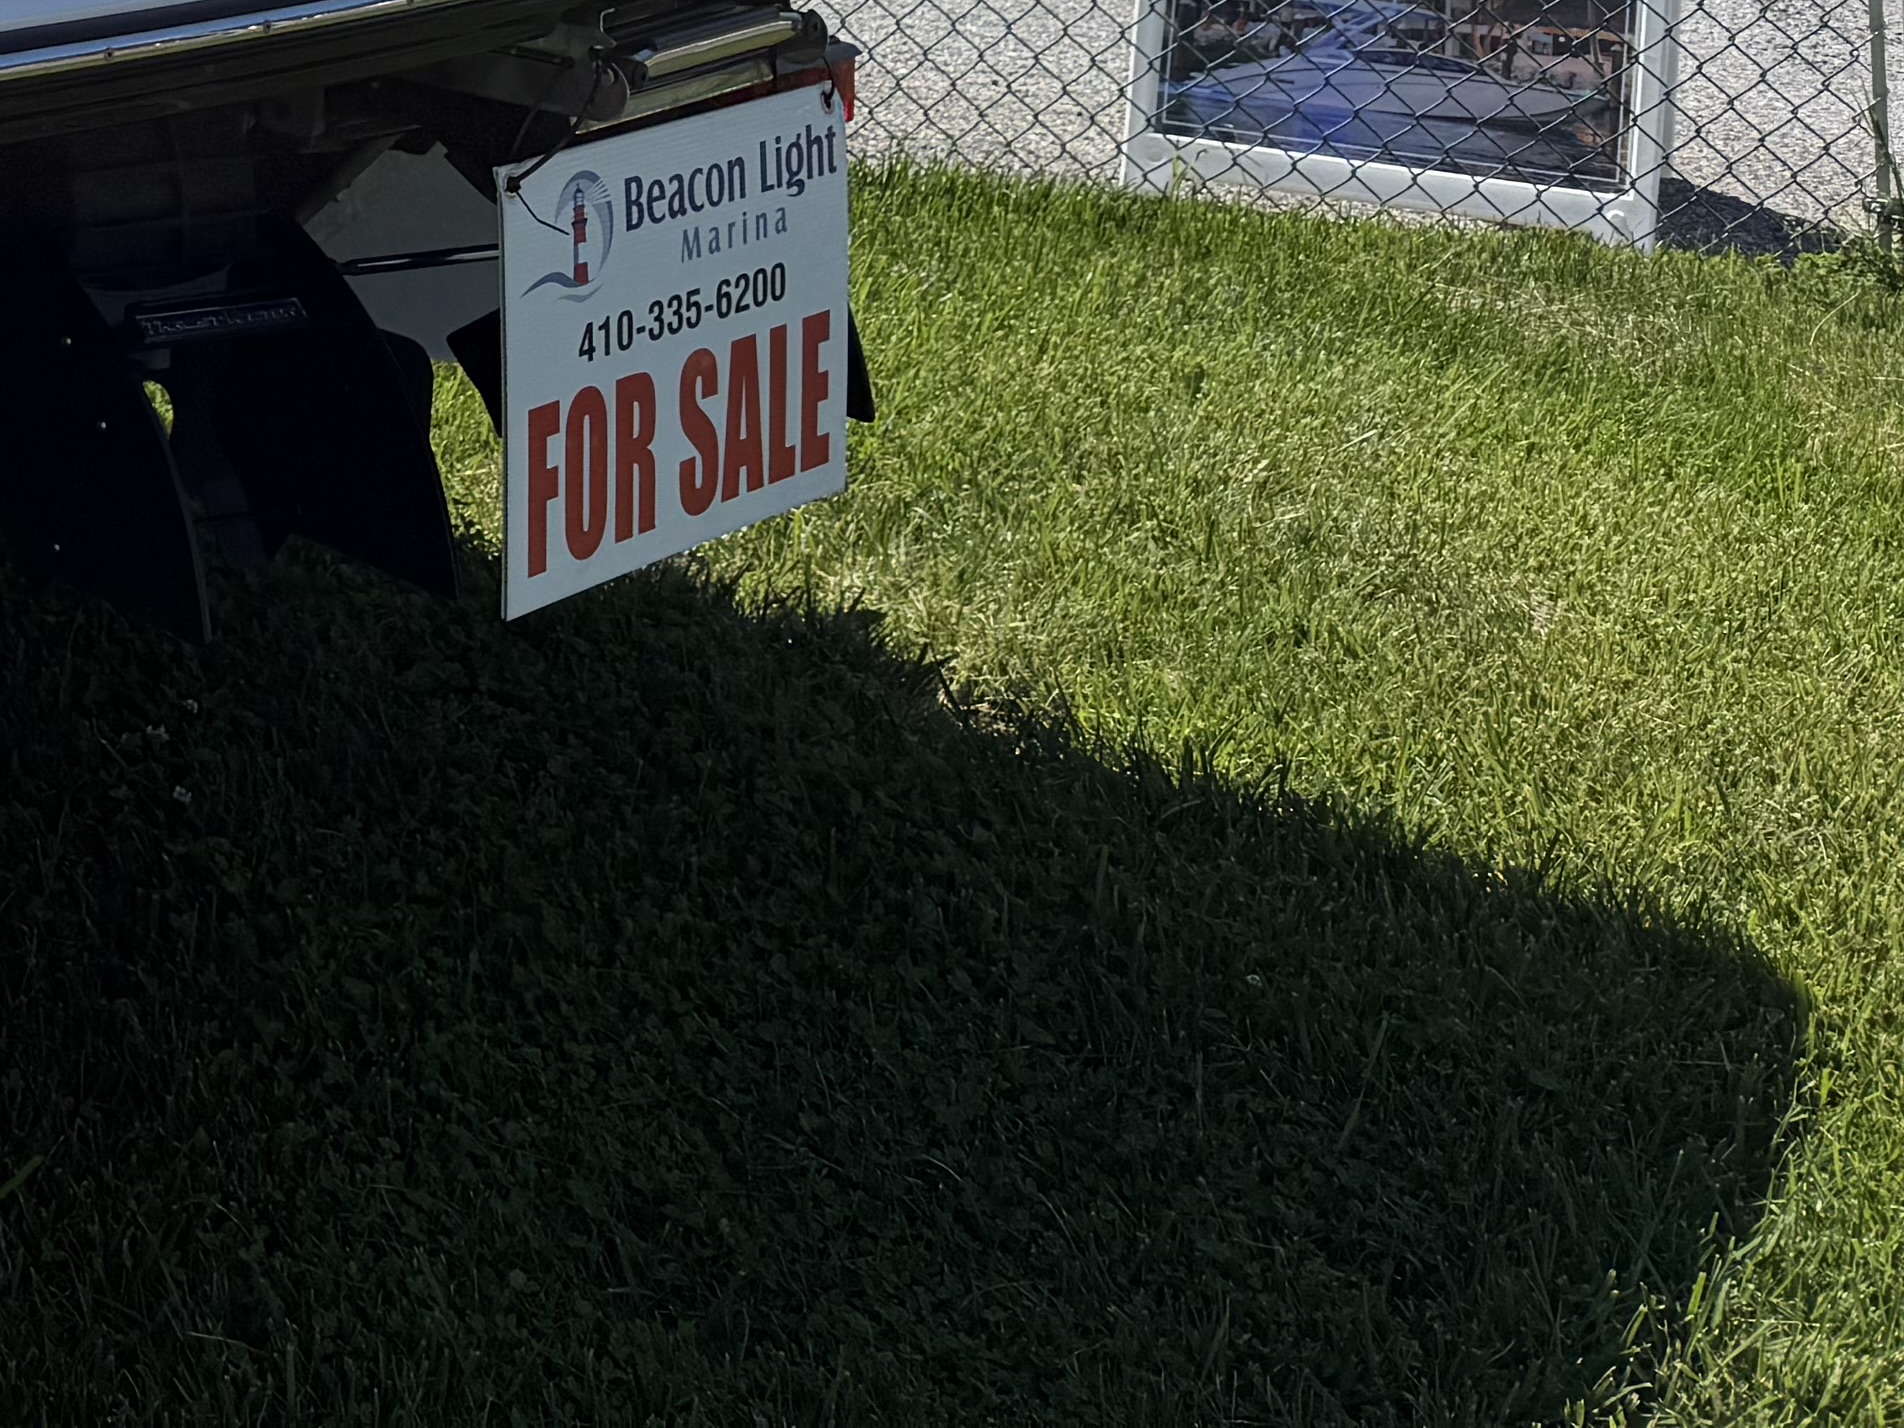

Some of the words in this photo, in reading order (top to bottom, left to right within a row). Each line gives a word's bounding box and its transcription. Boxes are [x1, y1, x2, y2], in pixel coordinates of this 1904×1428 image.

[624, 155, 747, 232] Beacon
[760, 123, 838, 197] Light
[681, 203, 789, 263] Marina
[578, 261, 788, 362] 410-335-6200
[528, 371, 657, 578] FOR
[679, 309, 831, 517] SALE
